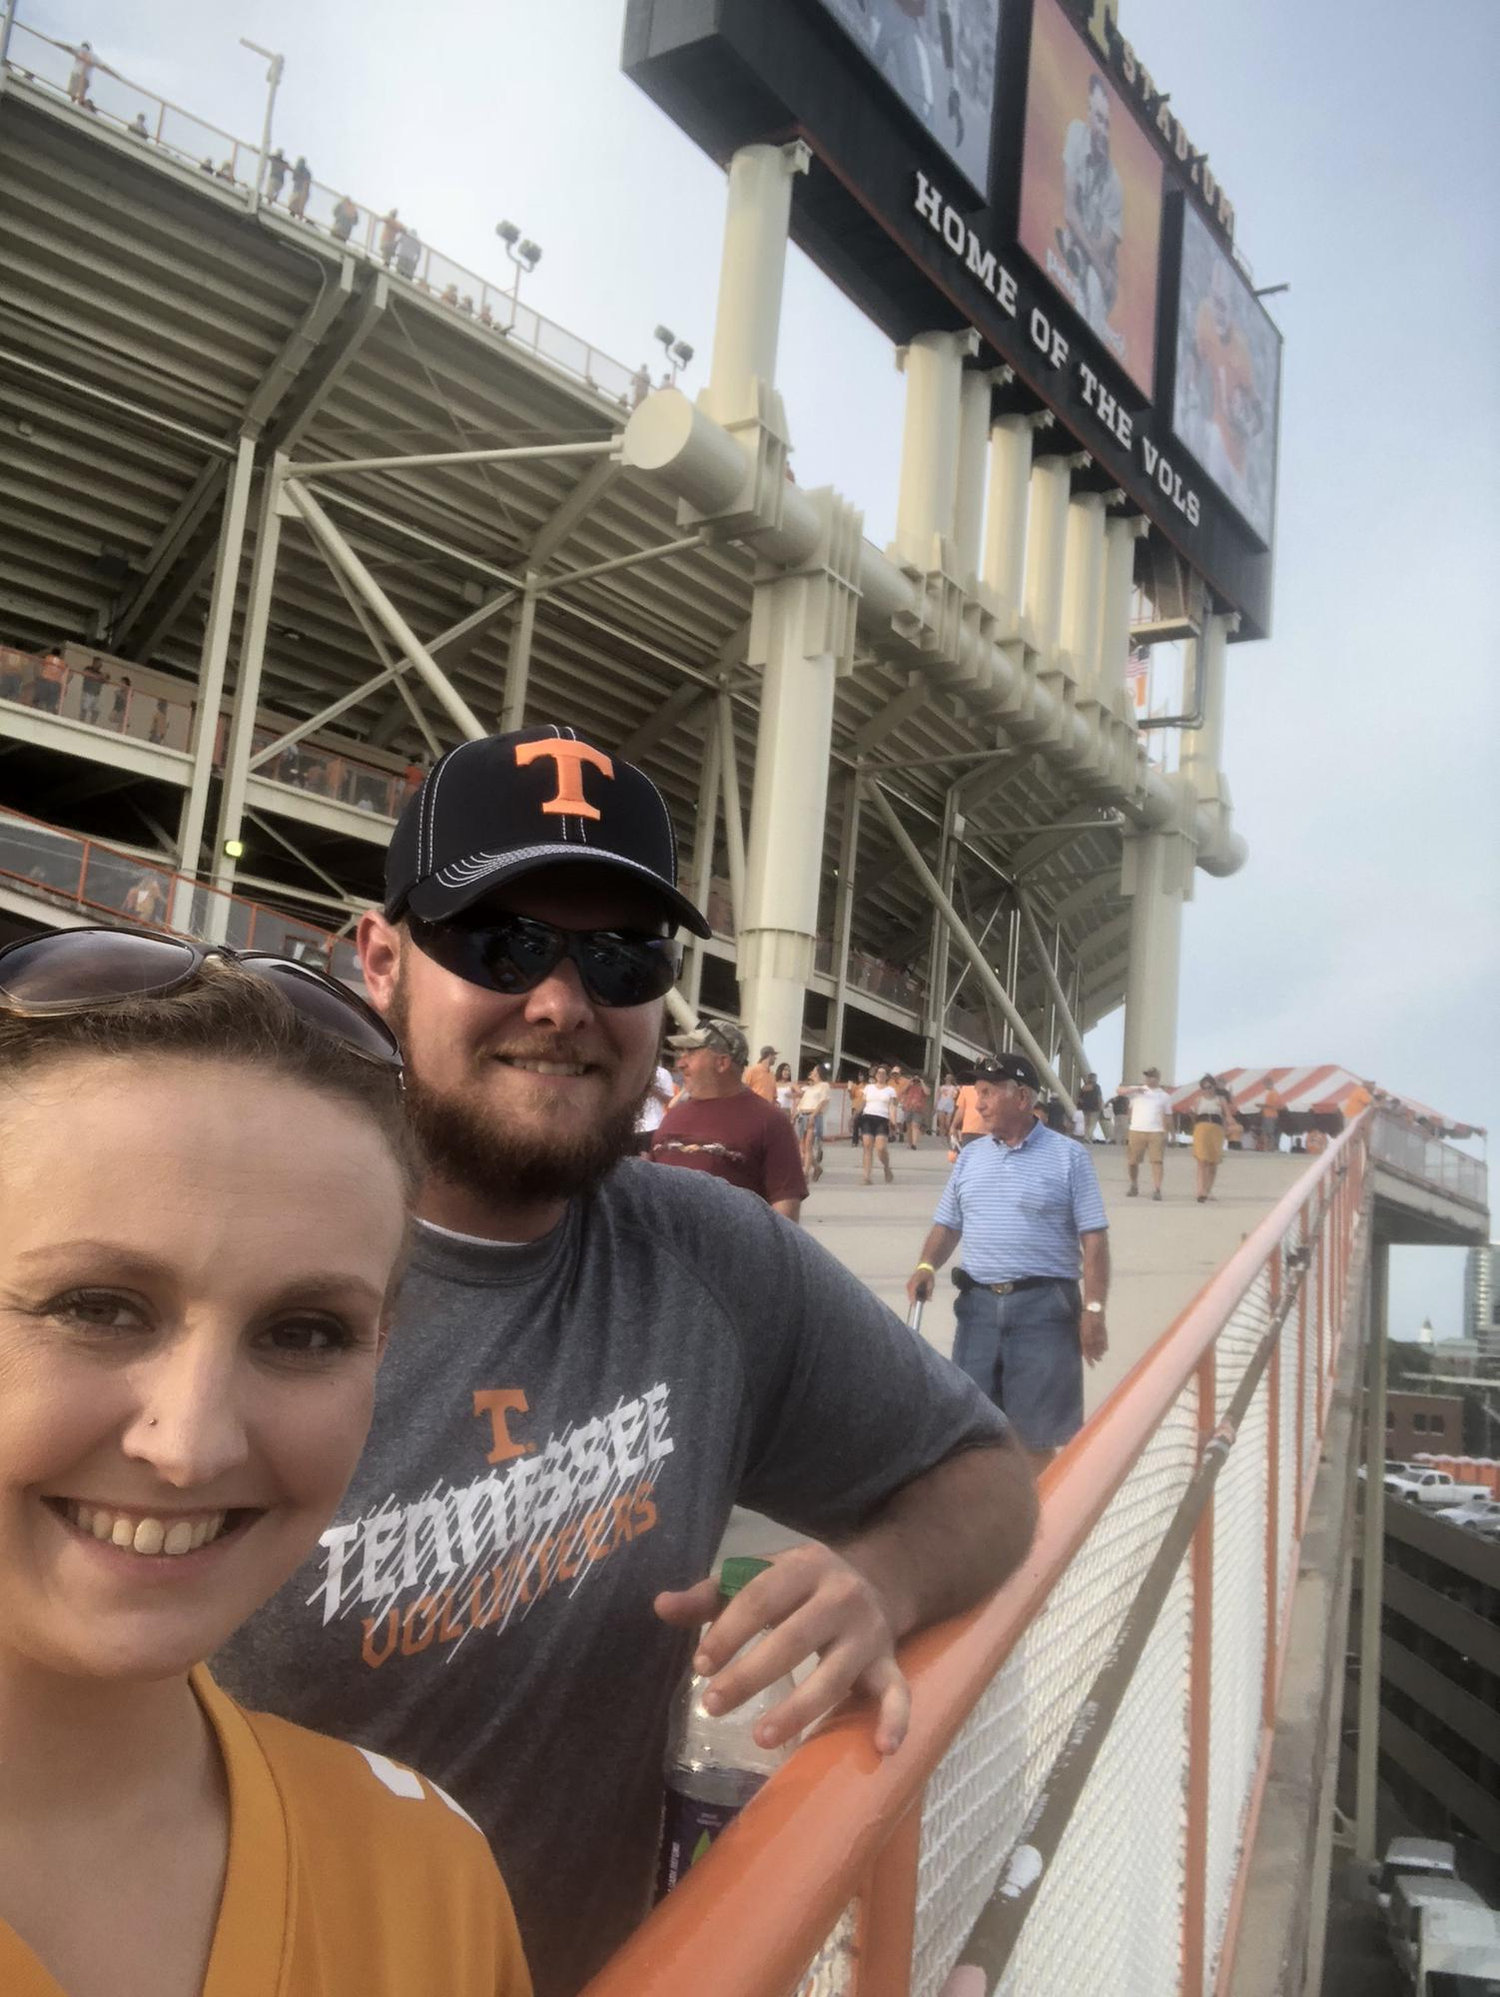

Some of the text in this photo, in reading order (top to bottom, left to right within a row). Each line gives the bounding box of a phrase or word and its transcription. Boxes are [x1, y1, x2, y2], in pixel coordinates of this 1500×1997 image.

[914, 170, 1019, 319] HOME
[1030, 307, 1069, 371] OF
[1079, 362, 1133, 450] THE
[1142, 436, 1201, 527] VOLS
[515, 737, 615, 821] T
[317, 1382, 675, 1627] TENNESSEE
[473, 1388, 530, 1465] T
[361, 1481, 659, 1669] VOLUNTEERS
